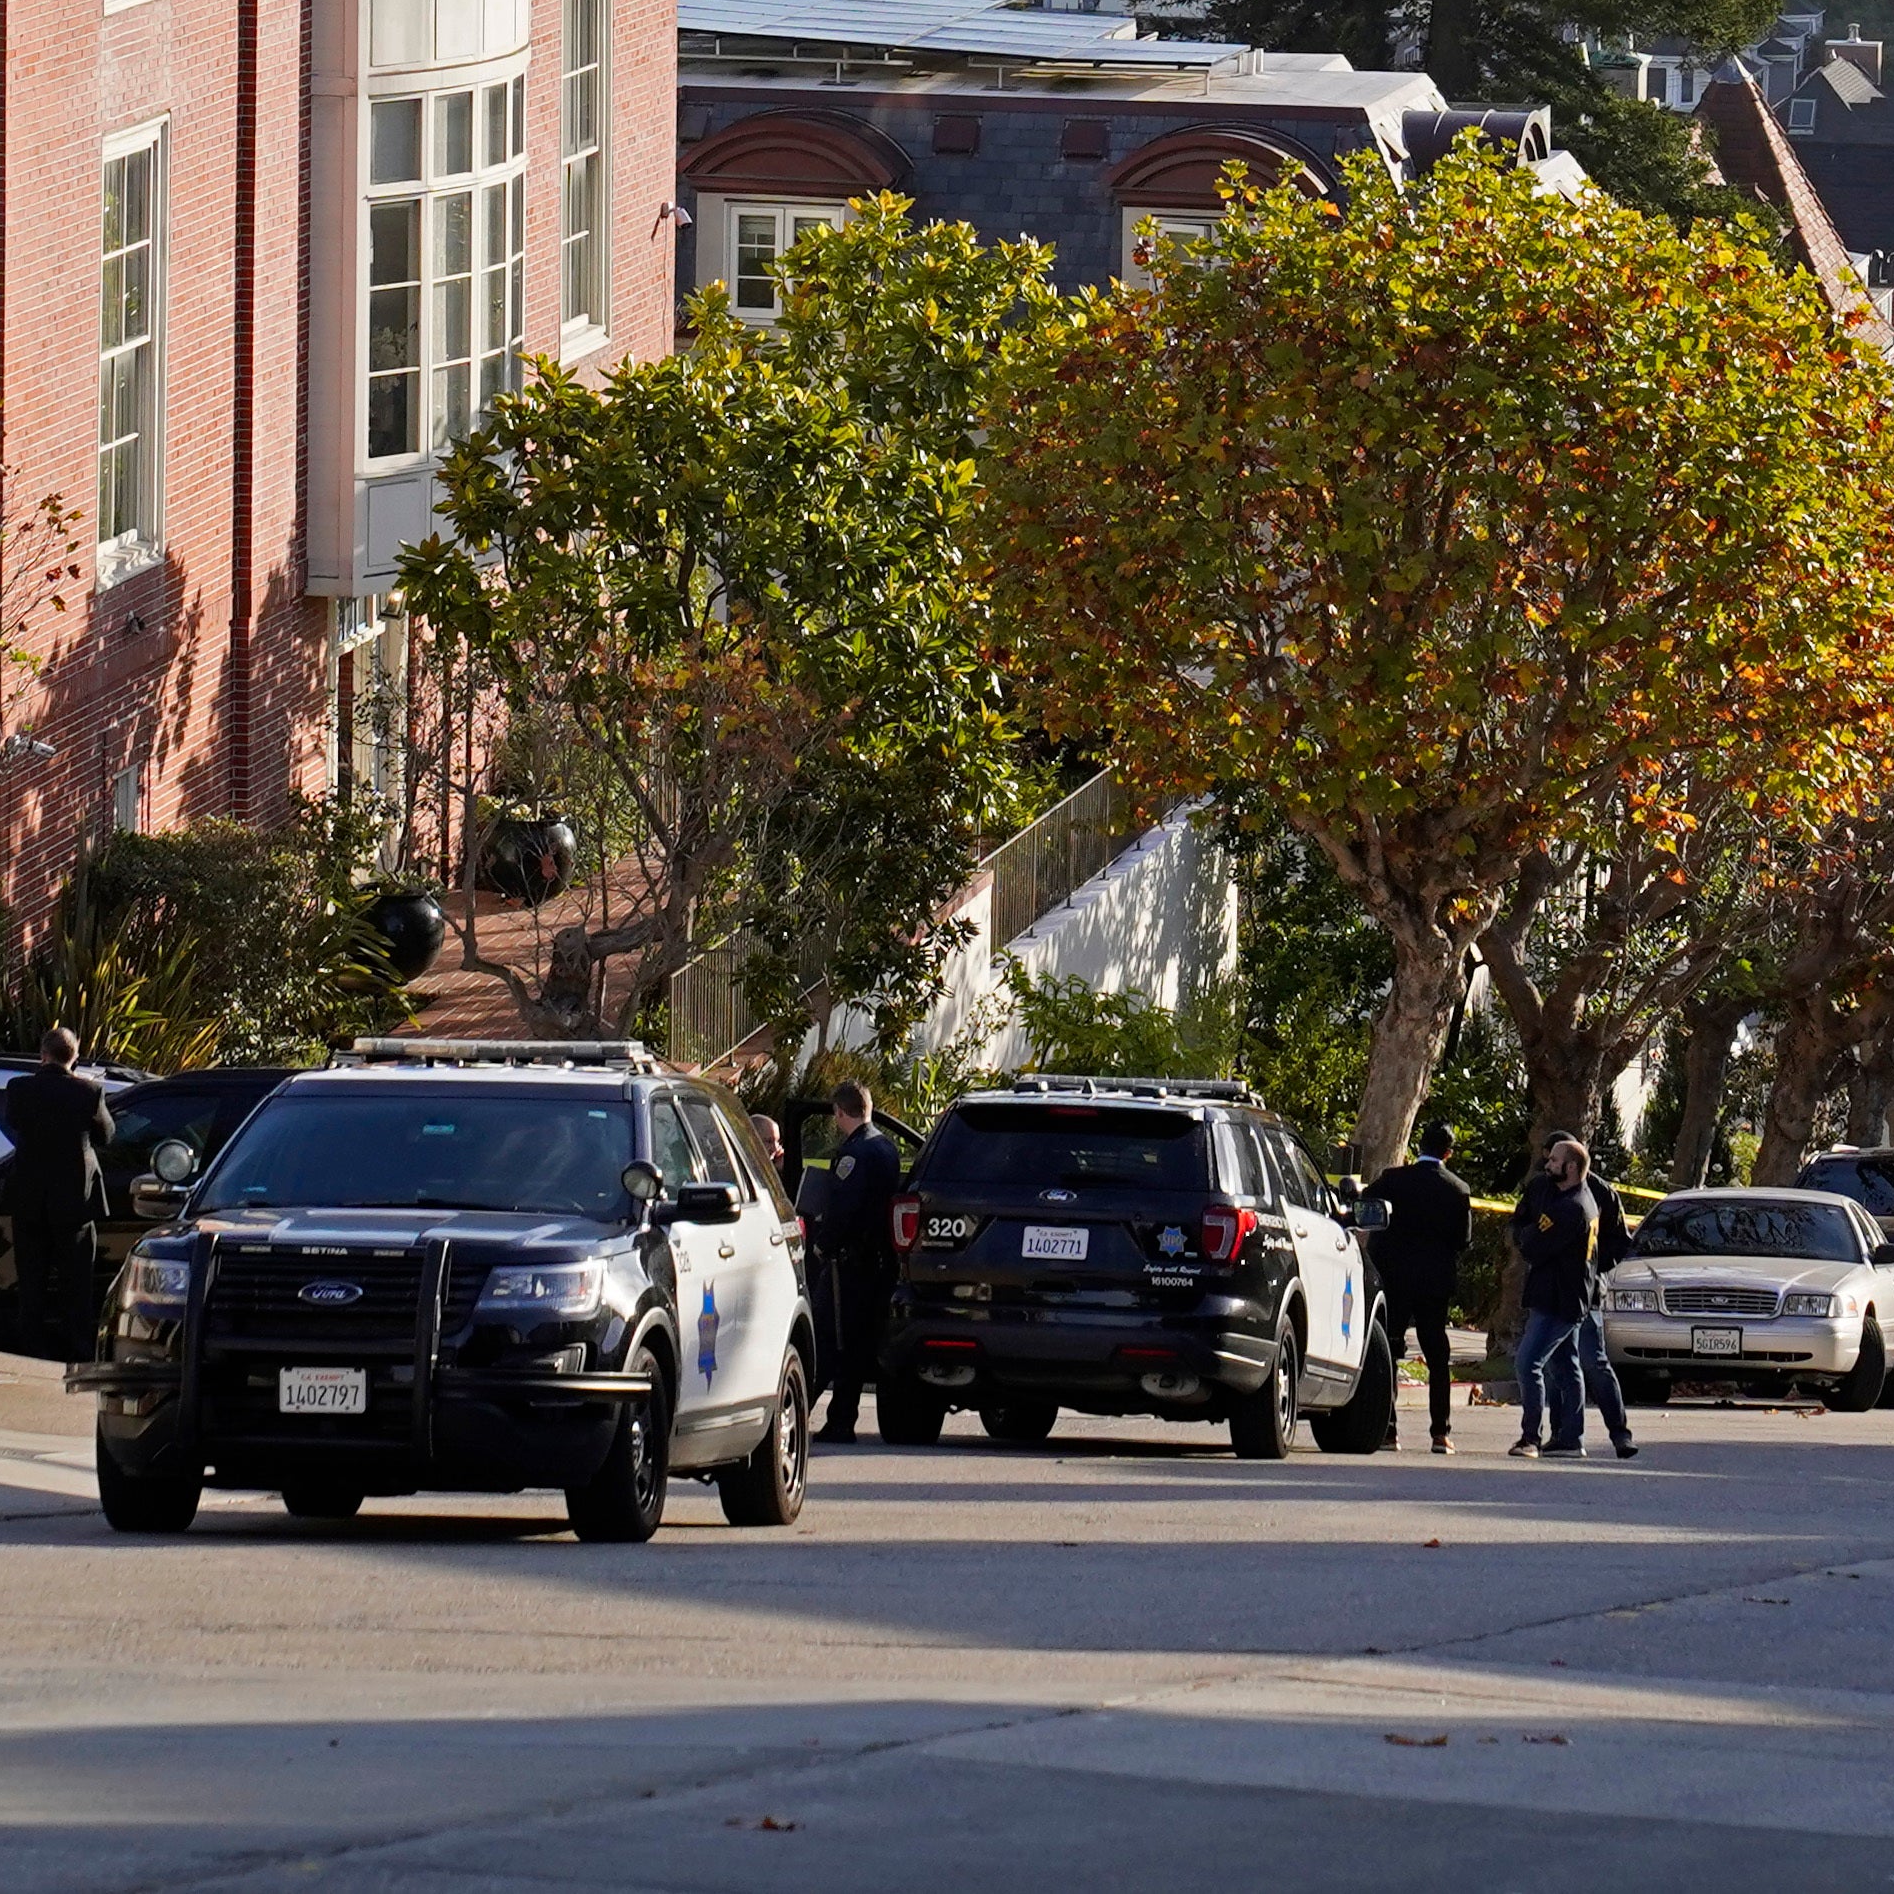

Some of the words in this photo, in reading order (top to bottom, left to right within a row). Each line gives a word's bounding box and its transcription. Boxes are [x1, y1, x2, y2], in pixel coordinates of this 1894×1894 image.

[928, 1218, 966, 1237] 320
[1027, 1238, 1082, 1255] 1402771
[311, 1286, 347, 1299] Ford
[286, 1385, 359, 1406] 1402797
